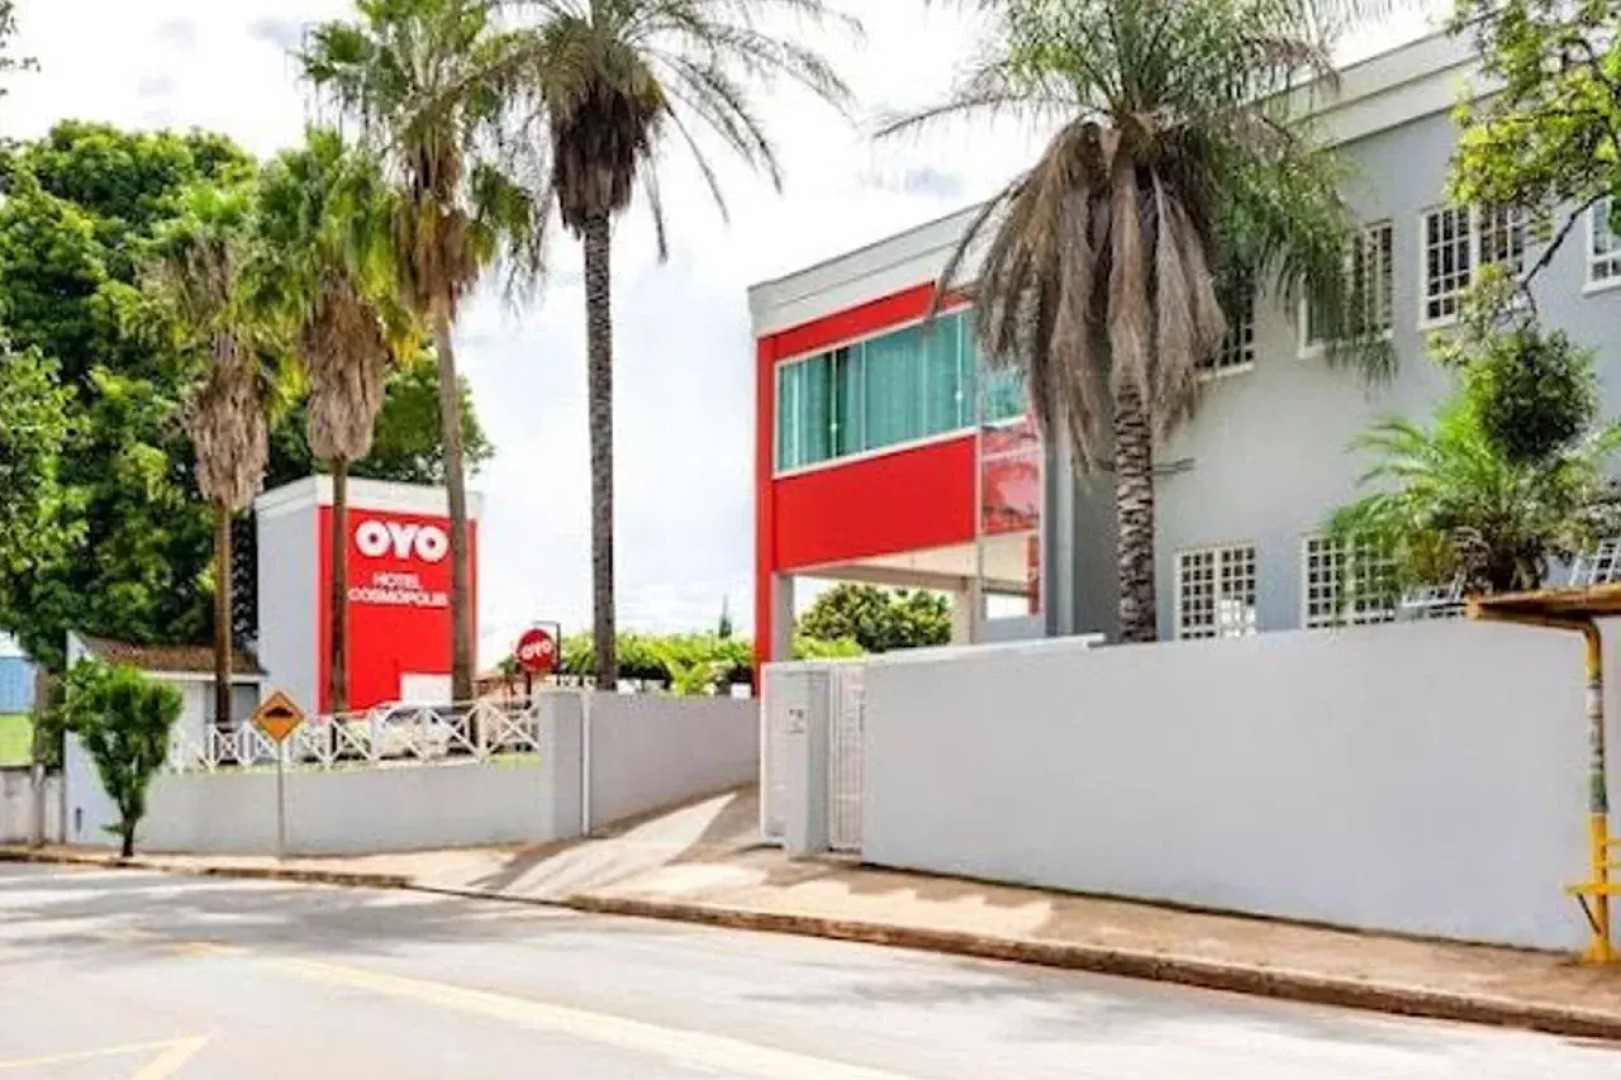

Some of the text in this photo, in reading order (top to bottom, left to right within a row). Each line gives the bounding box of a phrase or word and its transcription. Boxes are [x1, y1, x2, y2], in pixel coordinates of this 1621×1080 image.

[355, 519, 449, 562] OYO
[373, 572, 420, 589] HOTEL
[521, 639, 553, 660] OYO
